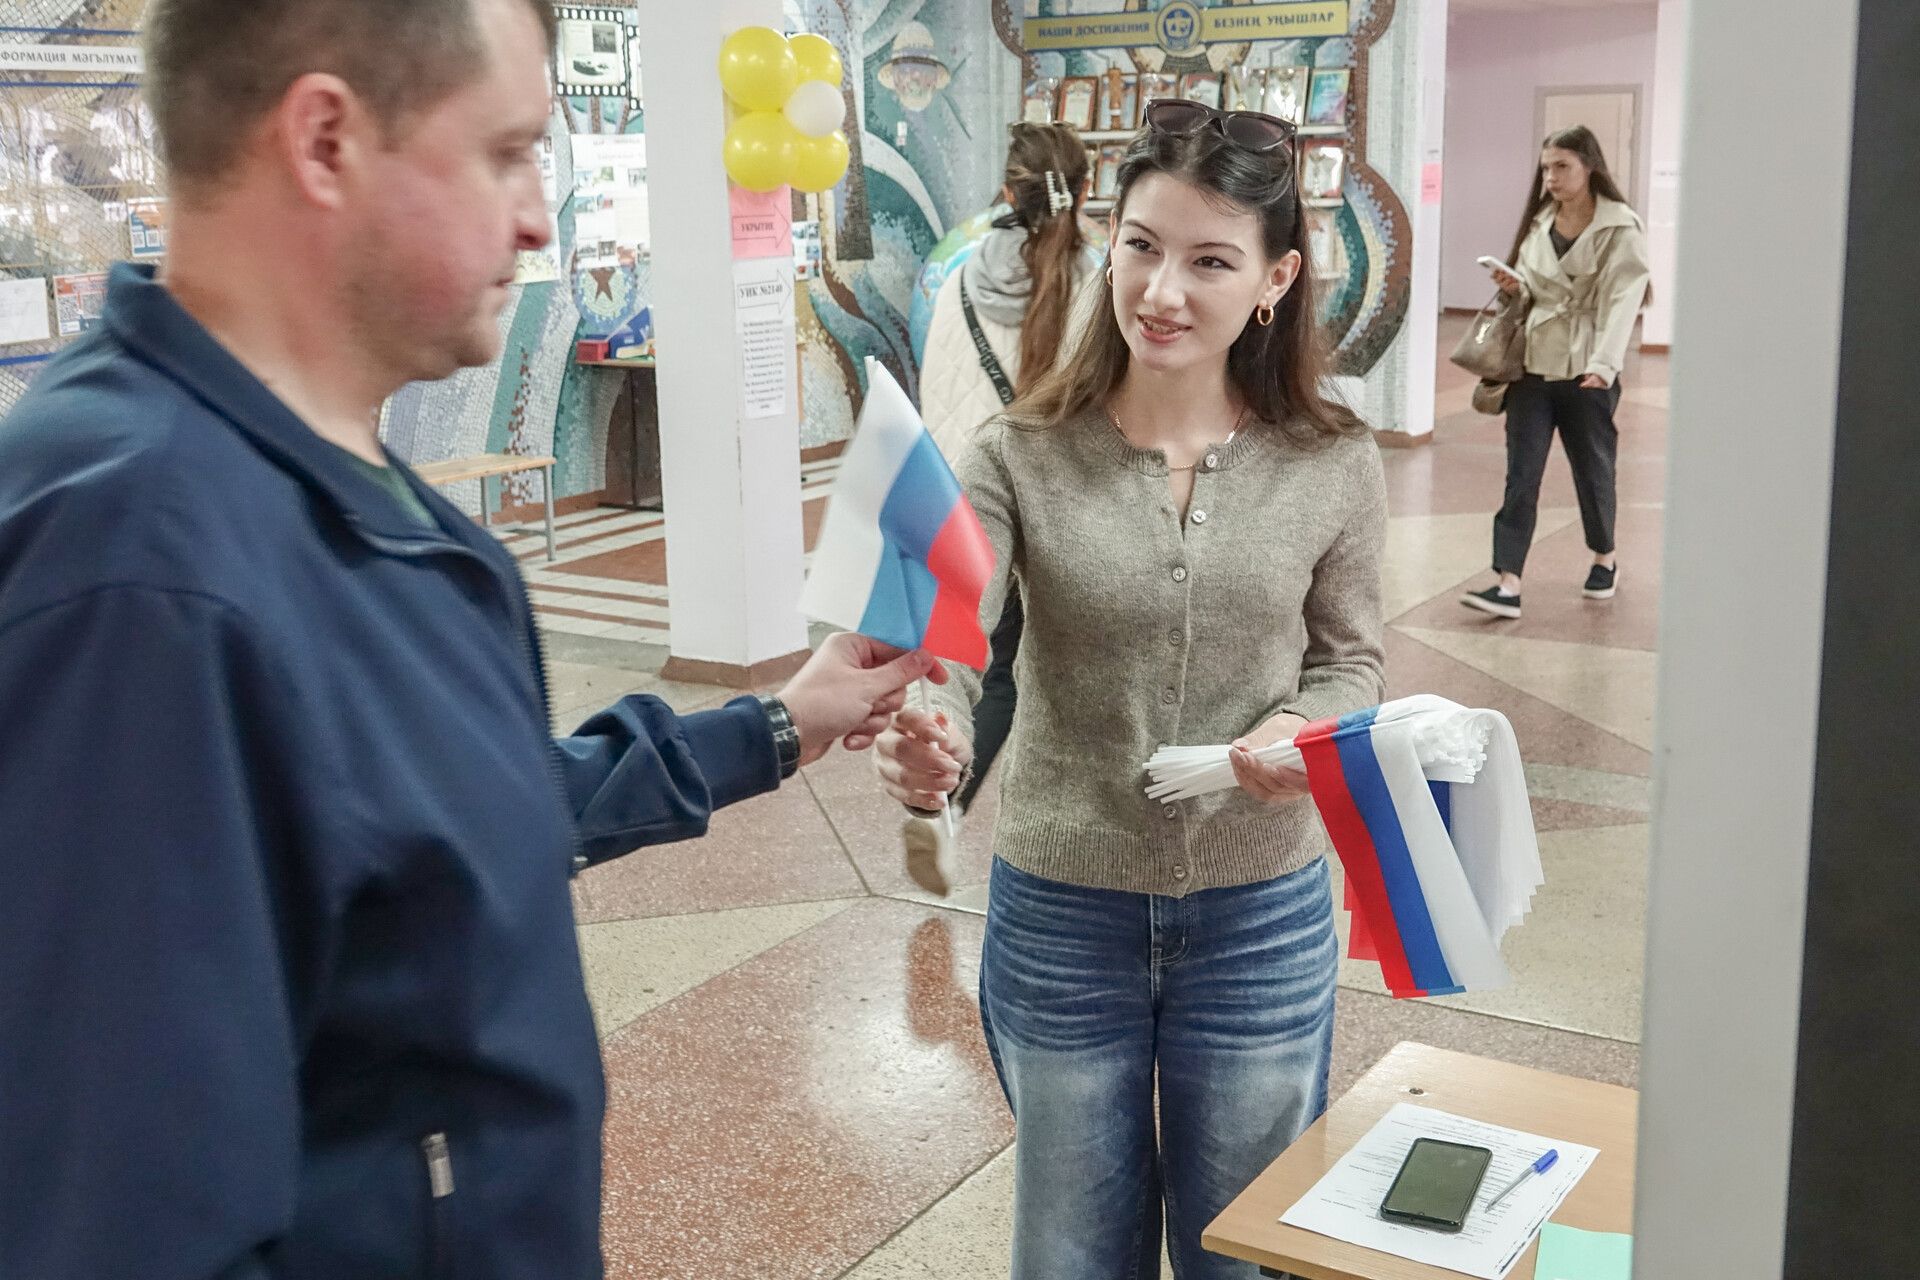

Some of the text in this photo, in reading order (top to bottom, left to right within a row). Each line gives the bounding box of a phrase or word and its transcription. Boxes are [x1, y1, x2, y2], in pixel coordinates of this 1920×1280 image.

[1038, 23, 1149, 37] НАШИ ДОСТИЖЕНИЯ
[740, 287, 758, 298] УИК
